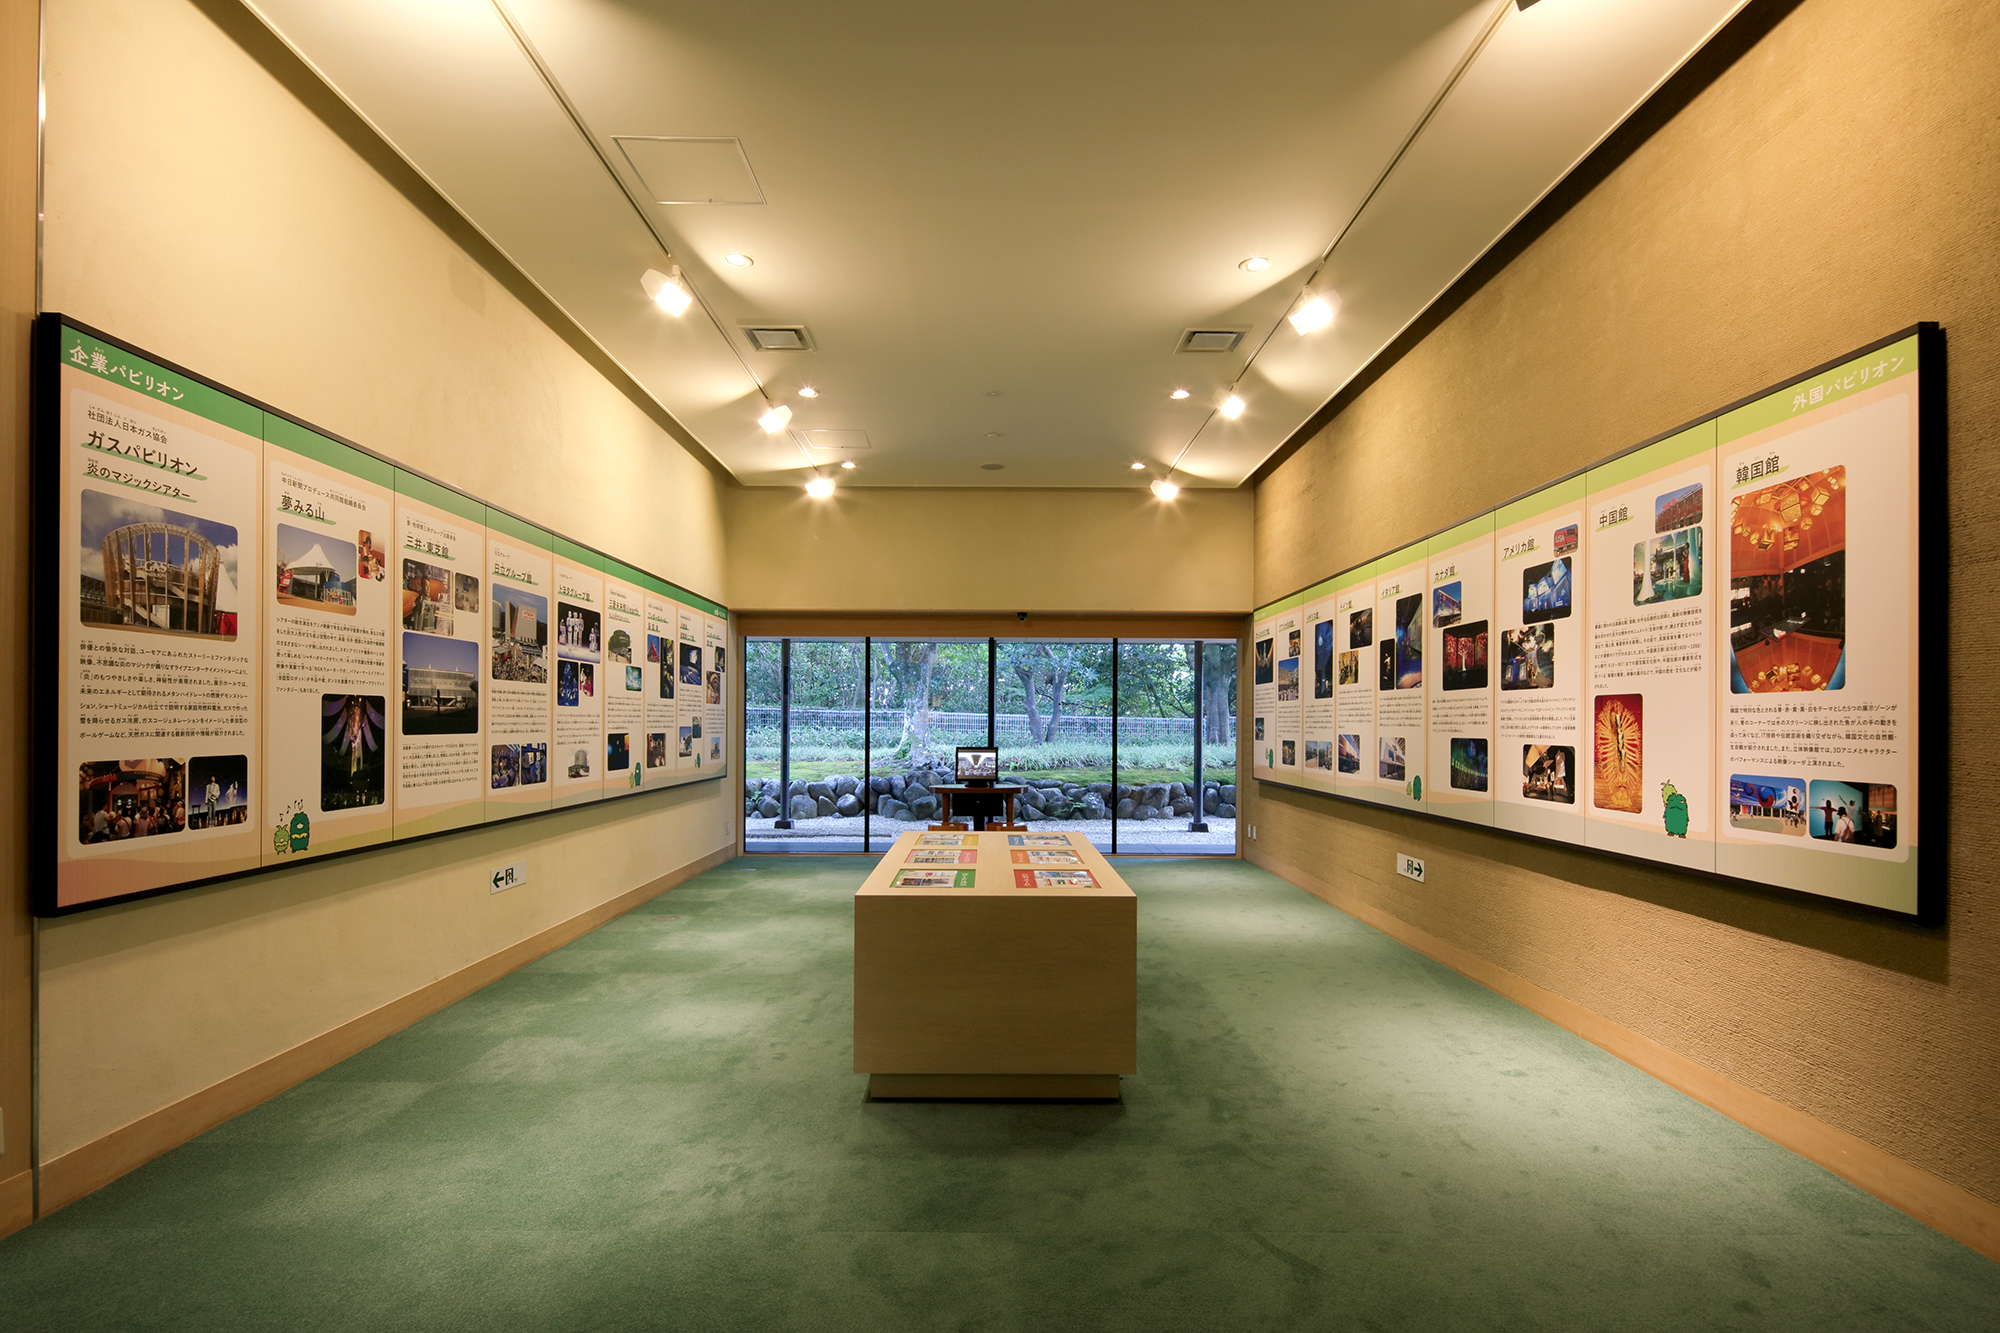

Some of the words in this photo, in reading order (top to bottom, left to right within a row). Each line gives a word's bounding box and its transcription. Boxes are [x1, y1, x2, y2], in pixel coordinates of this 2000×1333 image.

[69, 345, 184, 401] 企業パビリオン
[1792, 357, 1905, 412] 外国パビリオン
[88, 409, 168, 445] 社団法人日本ガス協会
[87, 430, 198, 476] ガスパビリオン
[87, 462, 190, 499] 炎のマジックシアター
[1736, 455, 1780, 485] 韓国館
[281, 494, 325, 522] 夢みる山
[1599, 506, 1629, 528] 中国館
[406, 535, 450, 559] 三井・東芝館
[1503, 538, 1535, 558] アメリカ館
[494, 563, 532, 584] 日立グループ館
[1434, 565, 1456, 582] カナダ館
